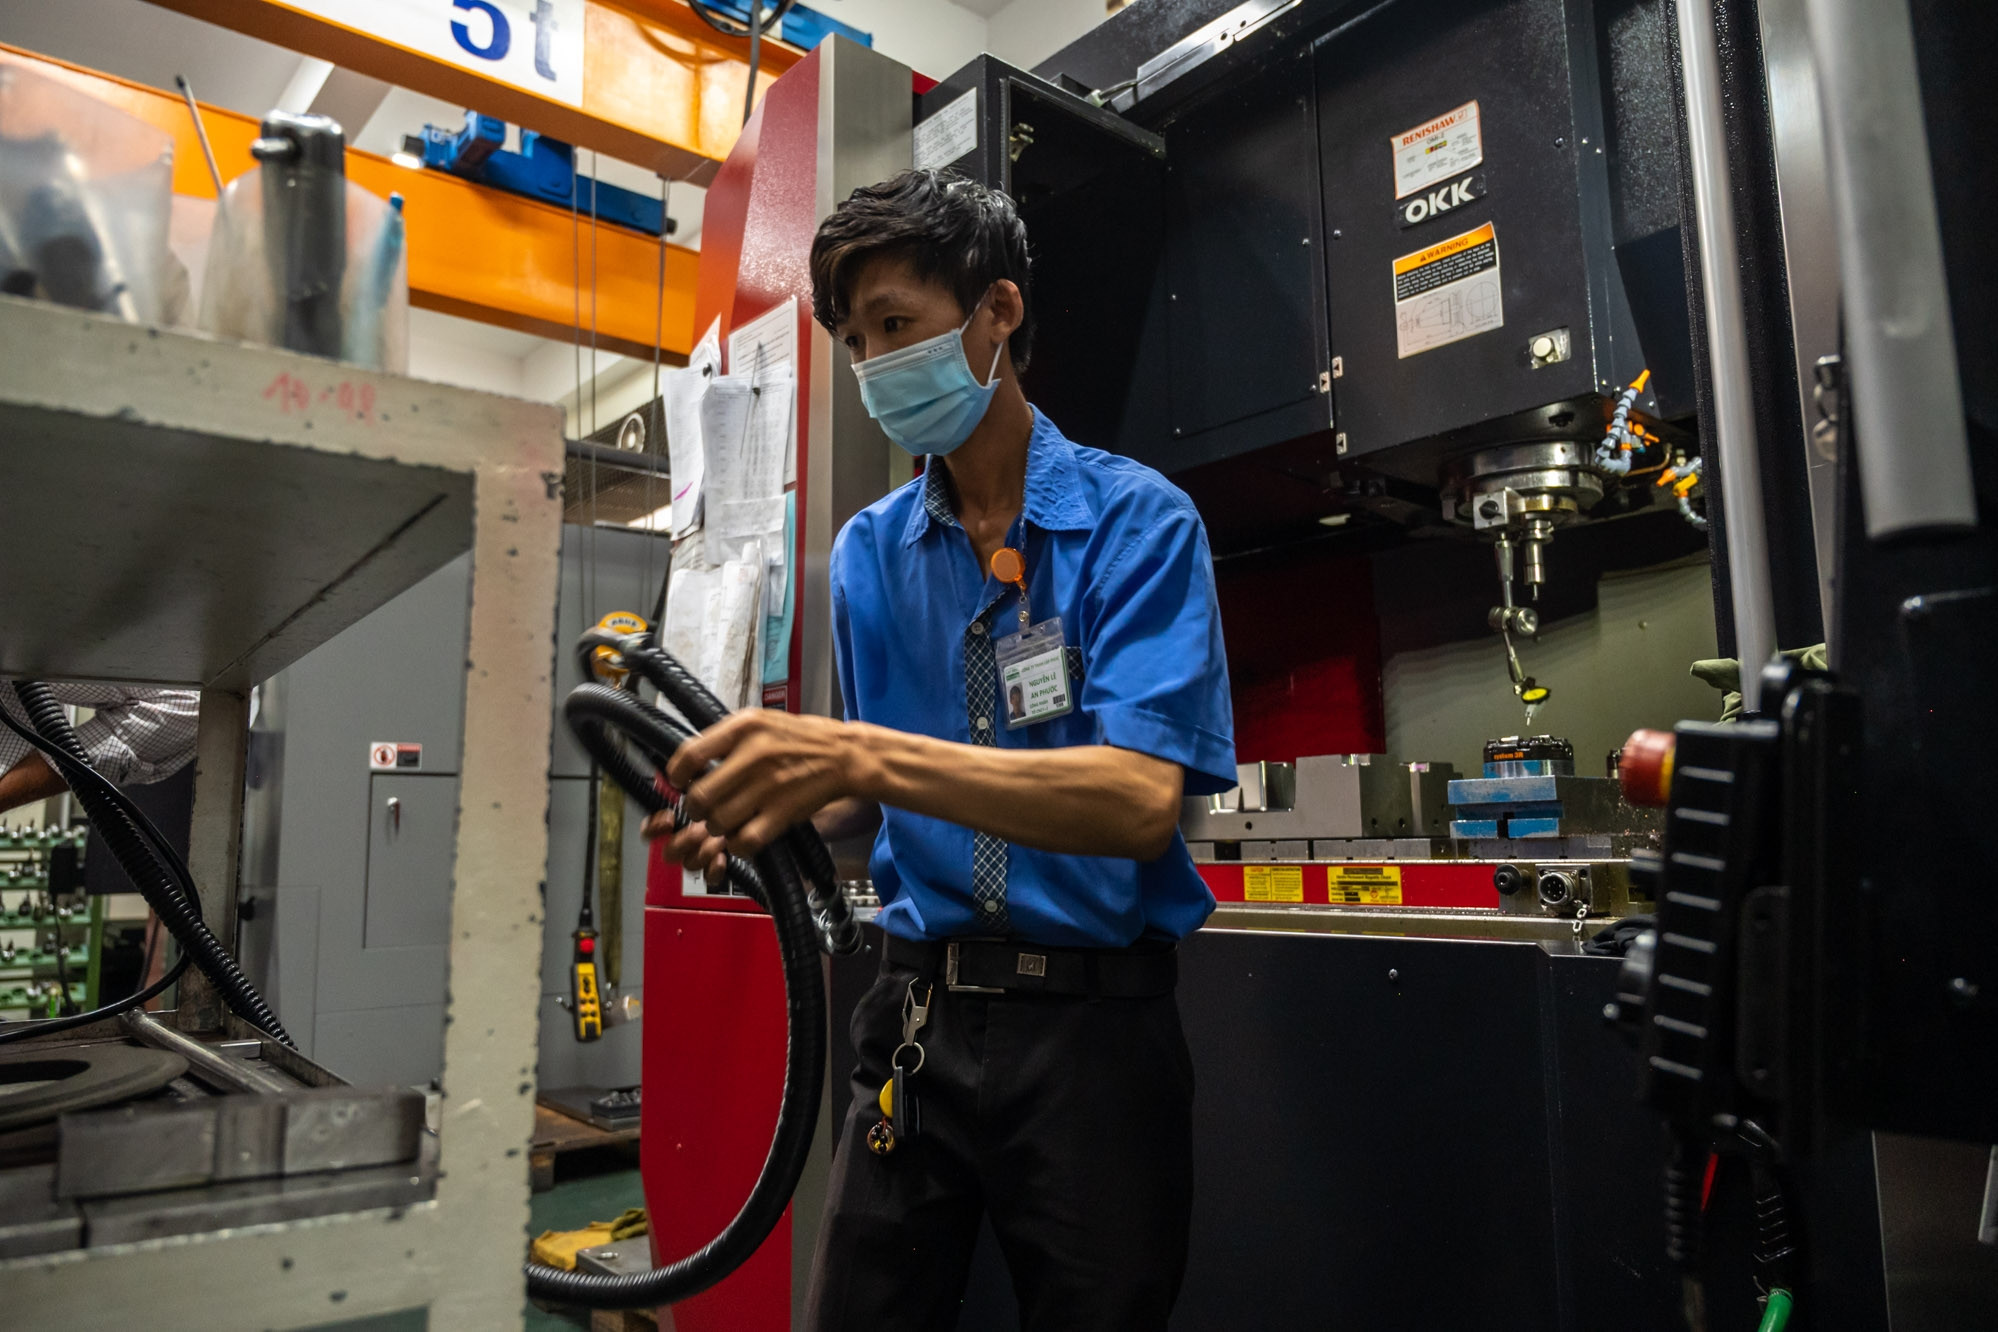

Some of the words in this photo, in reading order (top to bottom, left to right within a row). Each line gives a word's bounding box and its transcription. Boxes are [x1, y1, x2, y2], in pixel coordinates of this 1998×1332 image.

[1402, 115, 1456, 146] RENISHAW
[1405, 176, 1475, 223] OKK
[1426, 238, 1469, 259] WARNING
[1031, 691, 1039, 699] AN
